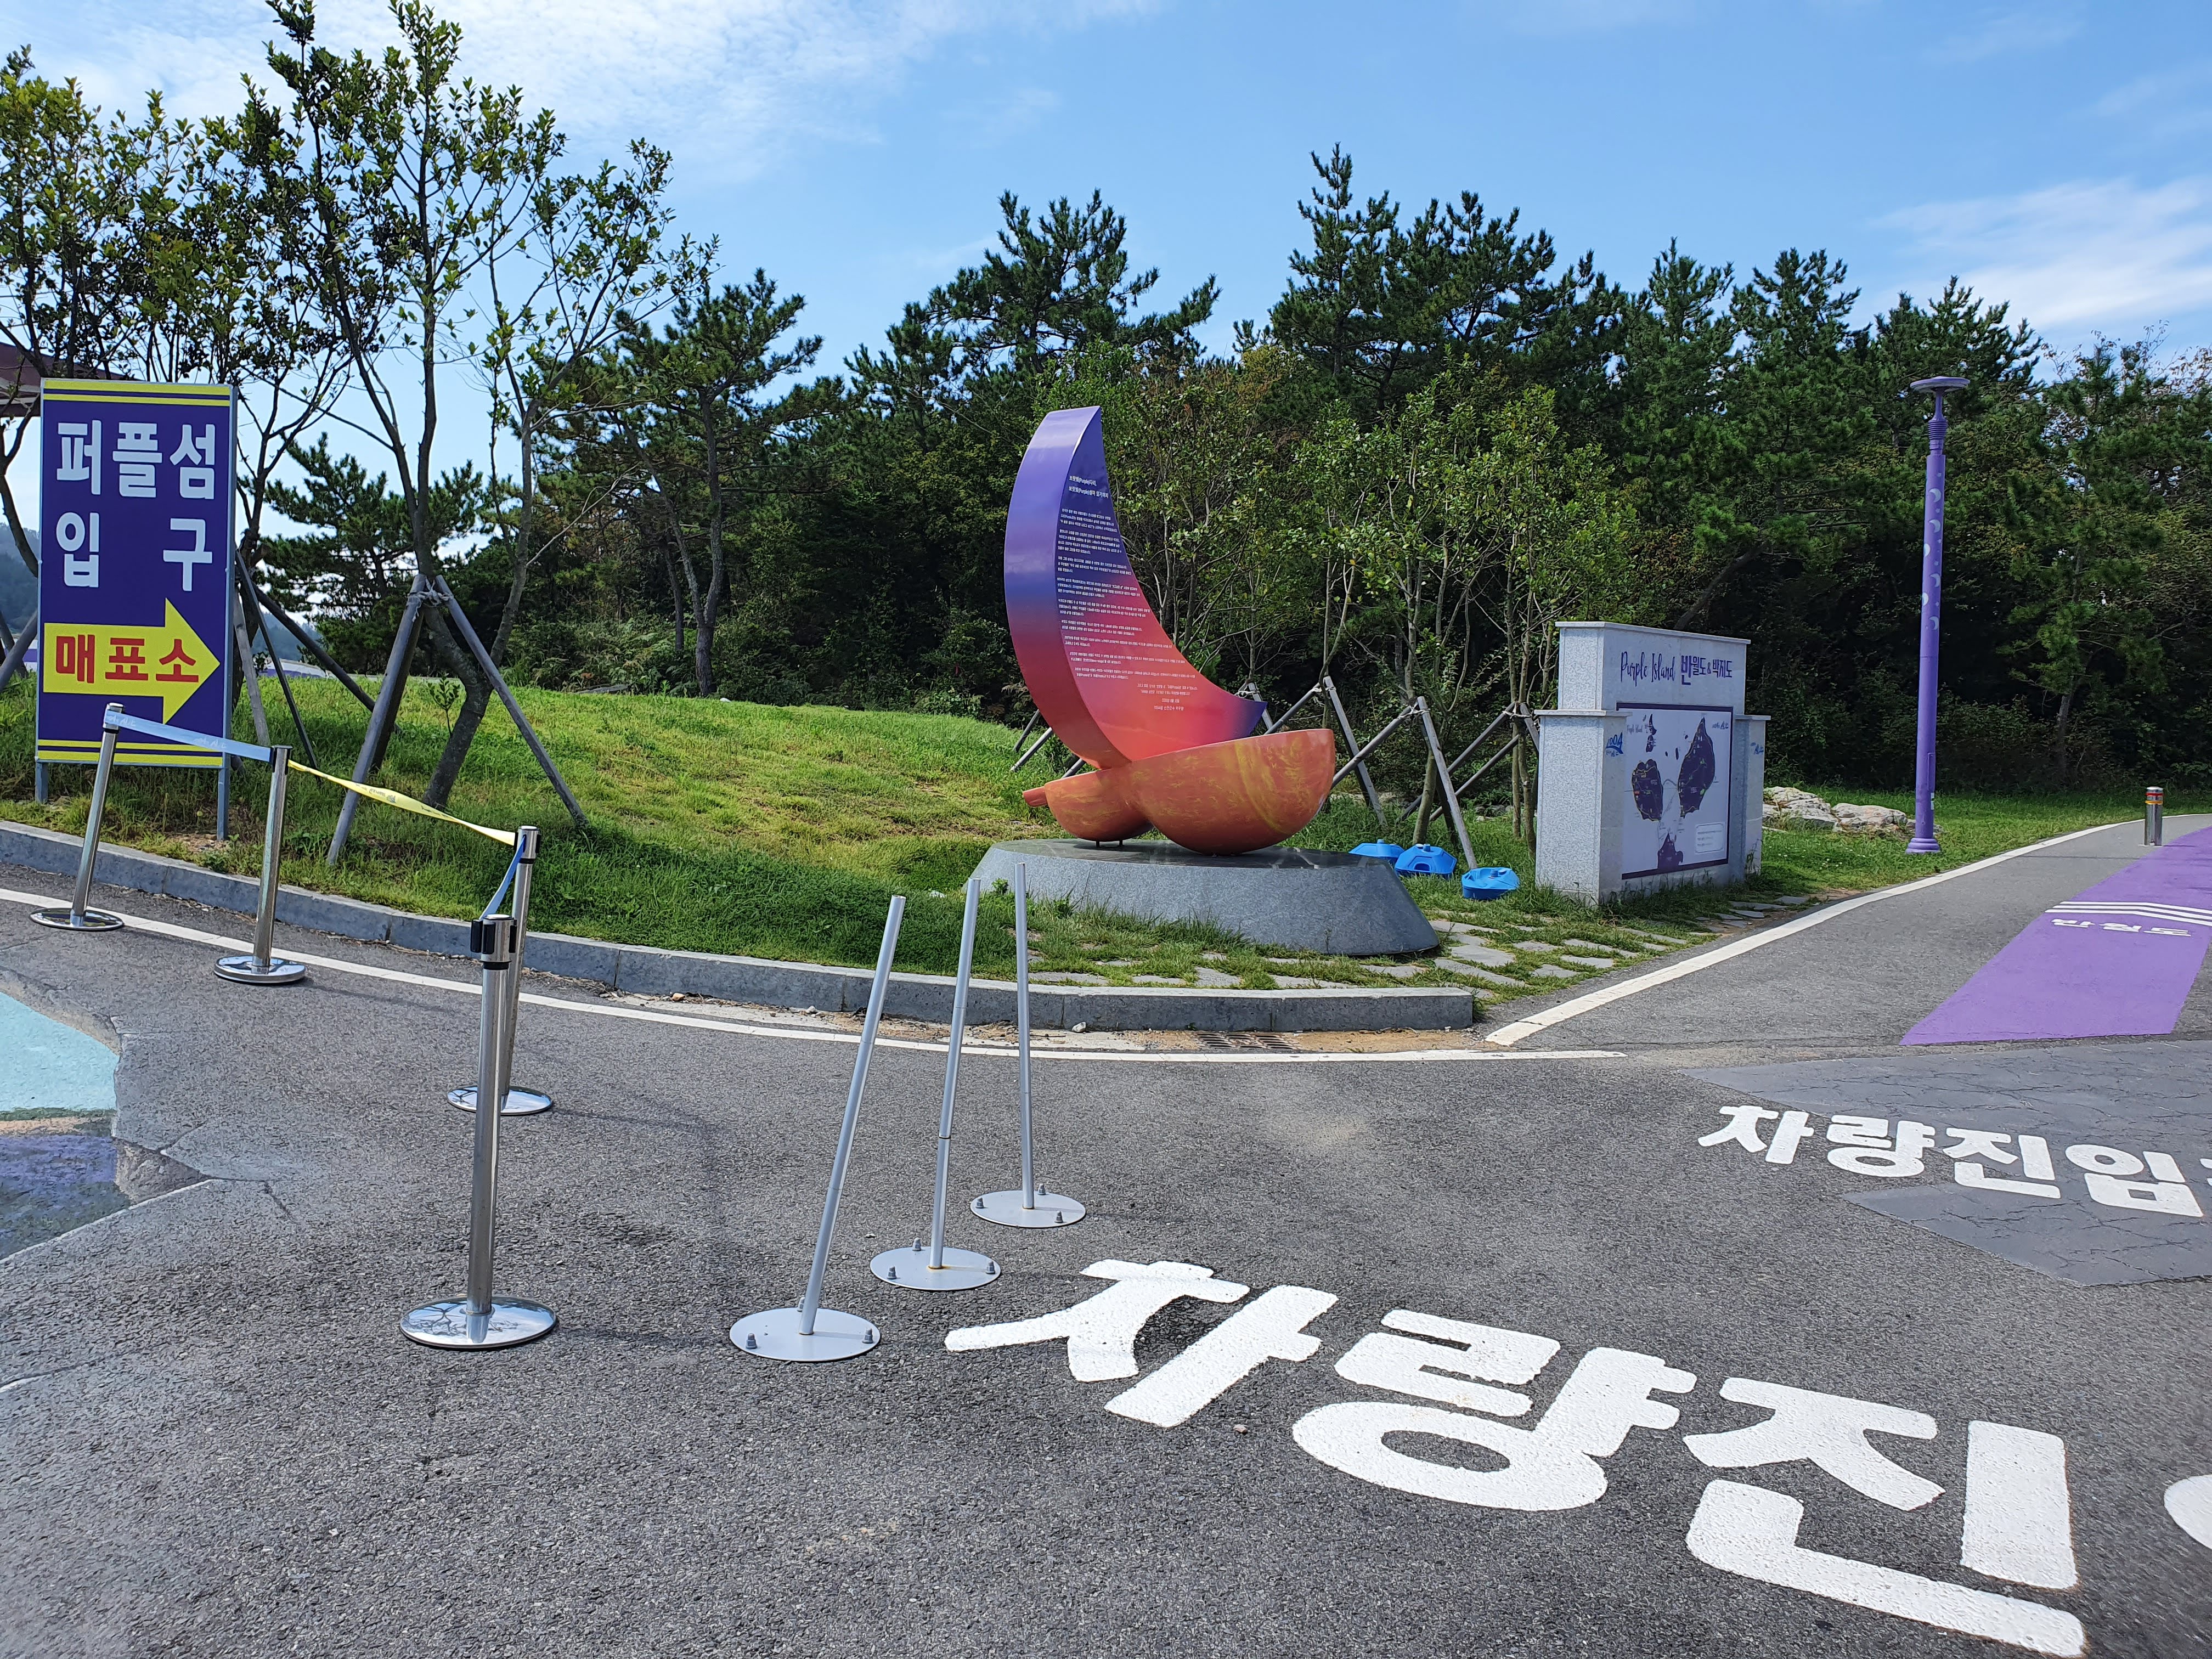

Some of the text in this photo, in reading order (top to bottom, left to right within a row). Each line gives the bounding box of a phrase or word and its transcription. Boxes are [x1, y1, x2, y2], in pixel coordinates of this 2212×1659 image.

[57, 420, 215, 499] 퍼플섬
[57, 635, 199, 684] 매표소
[1621, 651, 1648, 687] Purple
[1651, 653, 1676, 682] Island
[2051, 918, 2192, 936] 반월도
[1697, 1105, 2212, 1217] 차량진입
